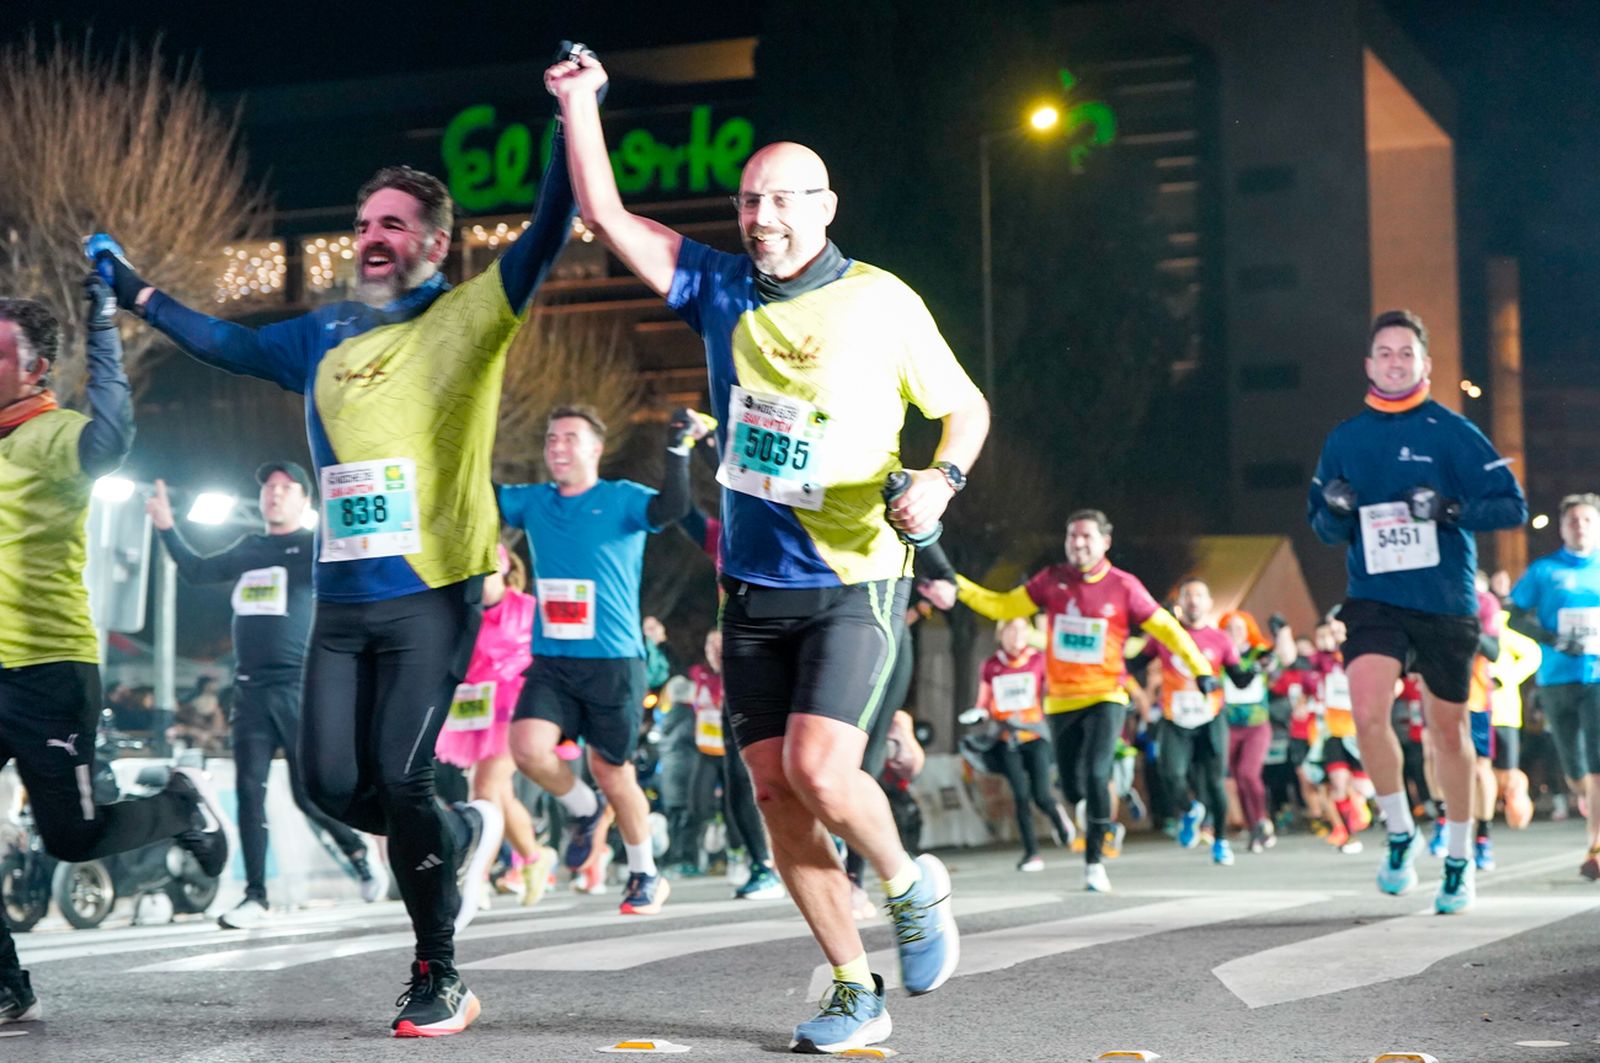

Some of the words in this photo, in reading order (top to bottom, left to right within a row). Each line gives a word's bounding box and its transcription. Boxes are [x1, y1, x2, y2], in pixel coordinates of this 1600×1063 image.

[442, 105, 536, 211] El
[541, 103, 754, 193] orte
[744, 427, 809, 470] 5035
[341, 494, 387, 527] 838
[1377, 527, 1420, 548] 5451
